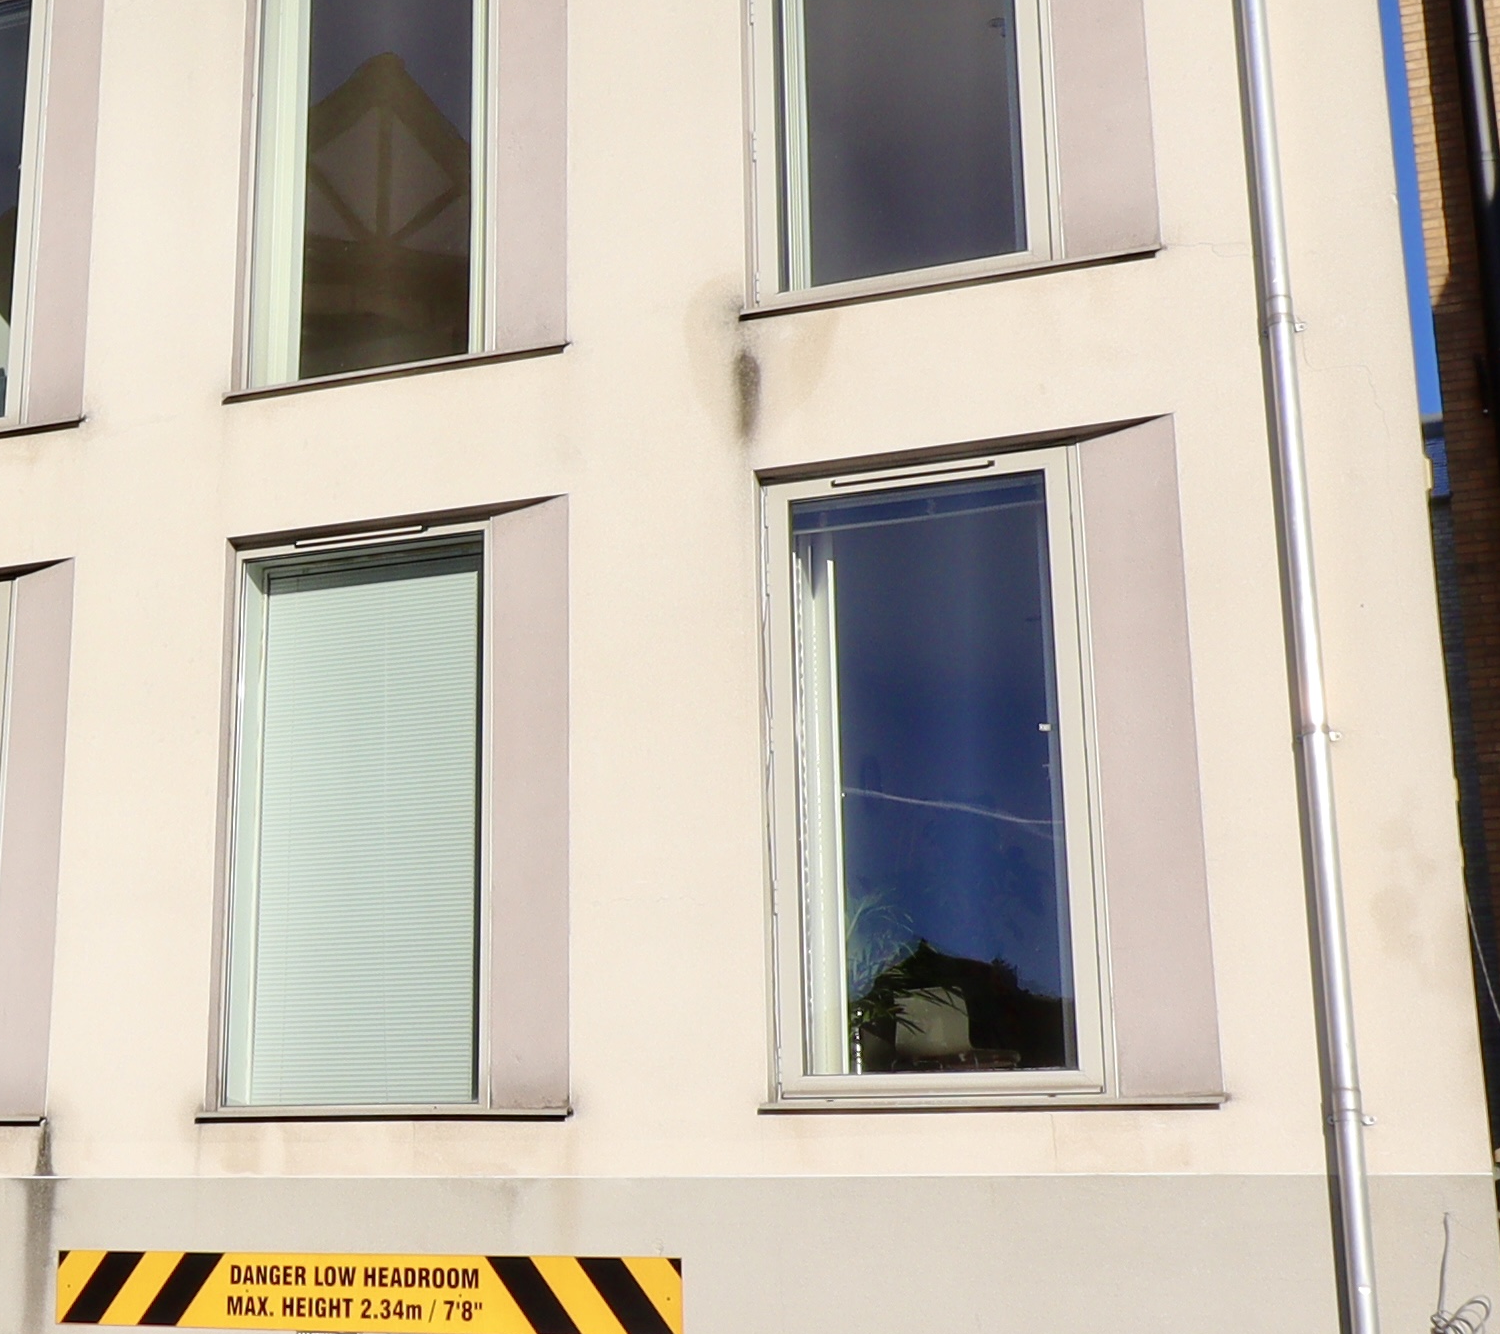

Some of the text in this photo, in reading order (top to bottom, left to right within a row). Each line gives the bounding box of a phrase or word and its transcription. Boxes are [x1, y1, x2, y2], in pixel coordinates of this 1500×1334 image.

[230, 1265, 480, 1289] DANGER LOW HEADROOM
[226, 1296, 274, 1317] MAX.
[282, 1297, 354, 1318] HEIGHT
[360, 1298, 422, 1320] 2.34m
